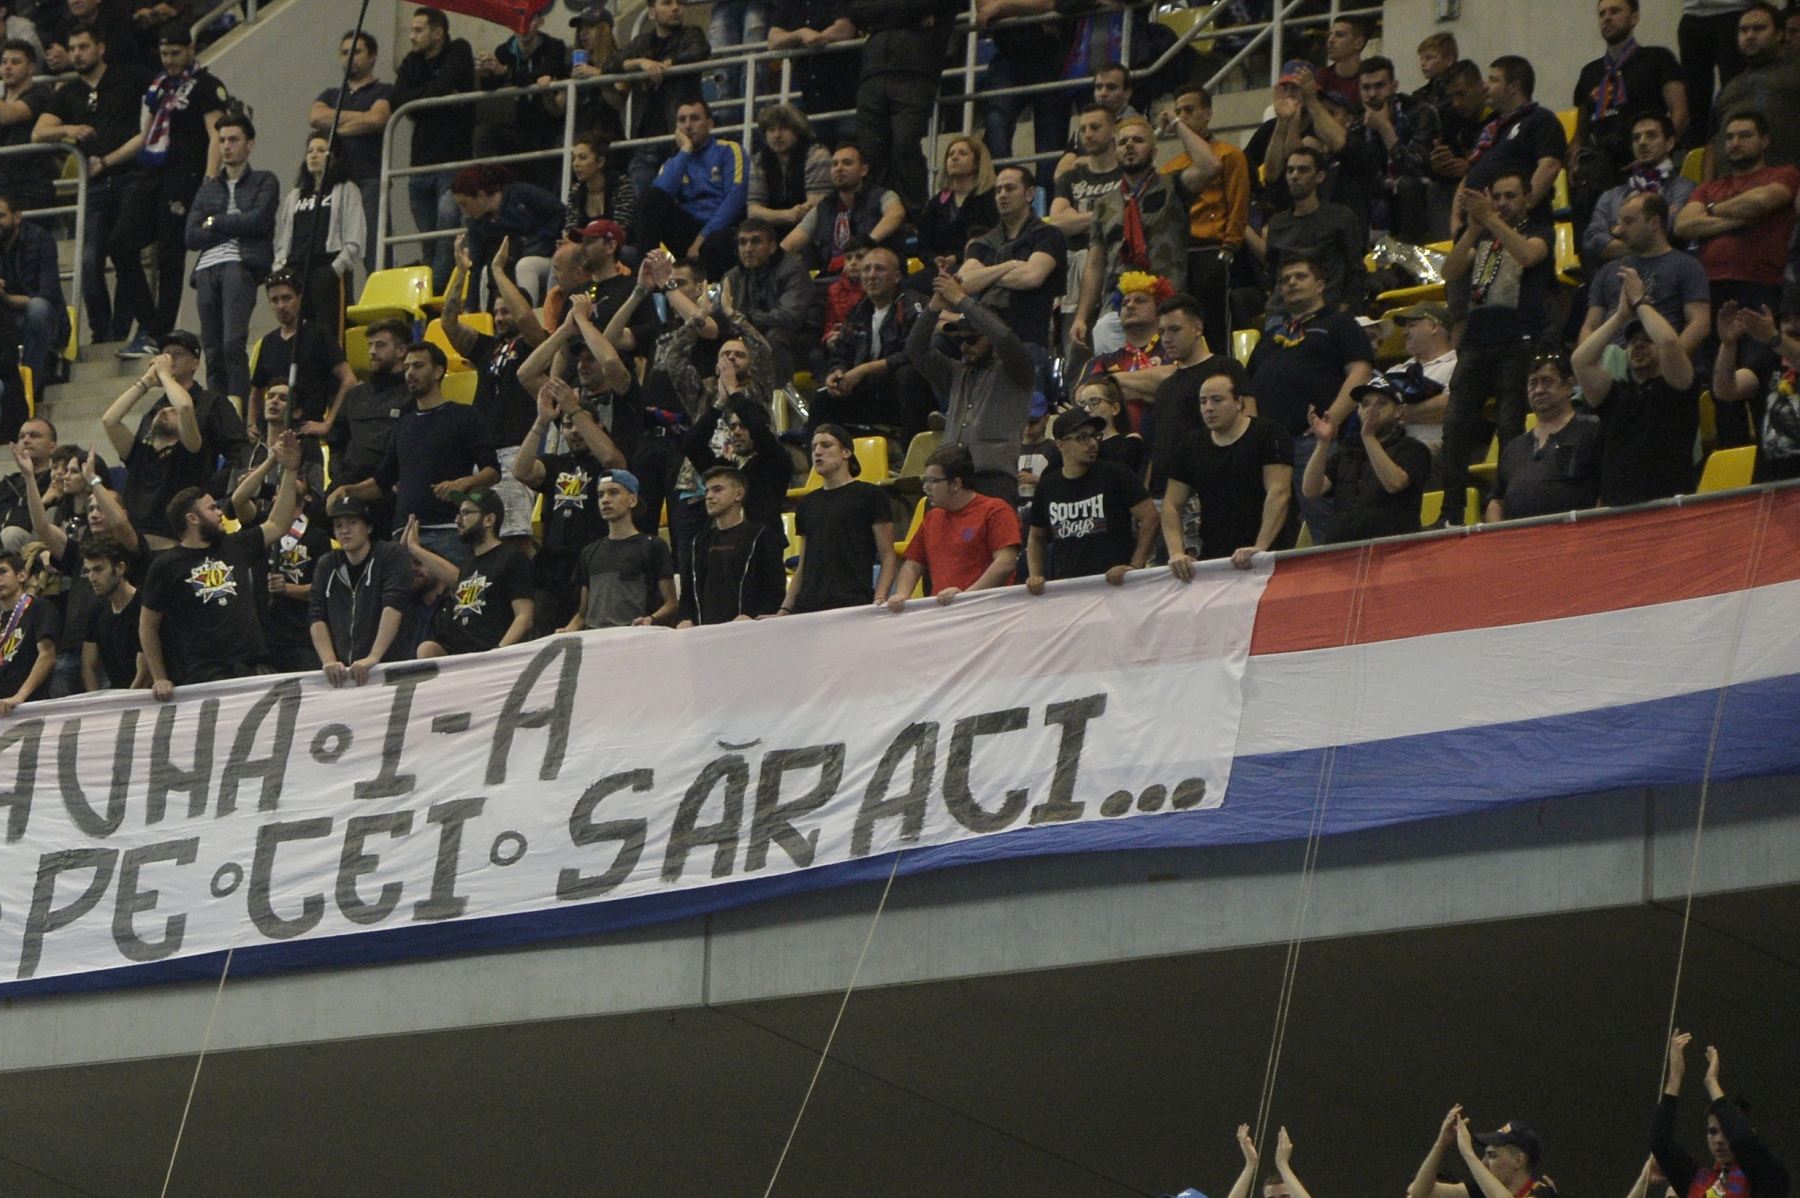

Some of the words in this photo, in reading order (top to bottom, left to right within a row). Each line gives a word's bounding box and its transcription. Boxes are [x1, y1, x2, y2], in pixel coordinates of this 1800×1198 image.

[1049, 493, 1104, 525] SOUTH
[1058, 517, 1095, 539] Boys
[16, 837, 199, 979] PE
[246, 796, 484, 941] CEI
